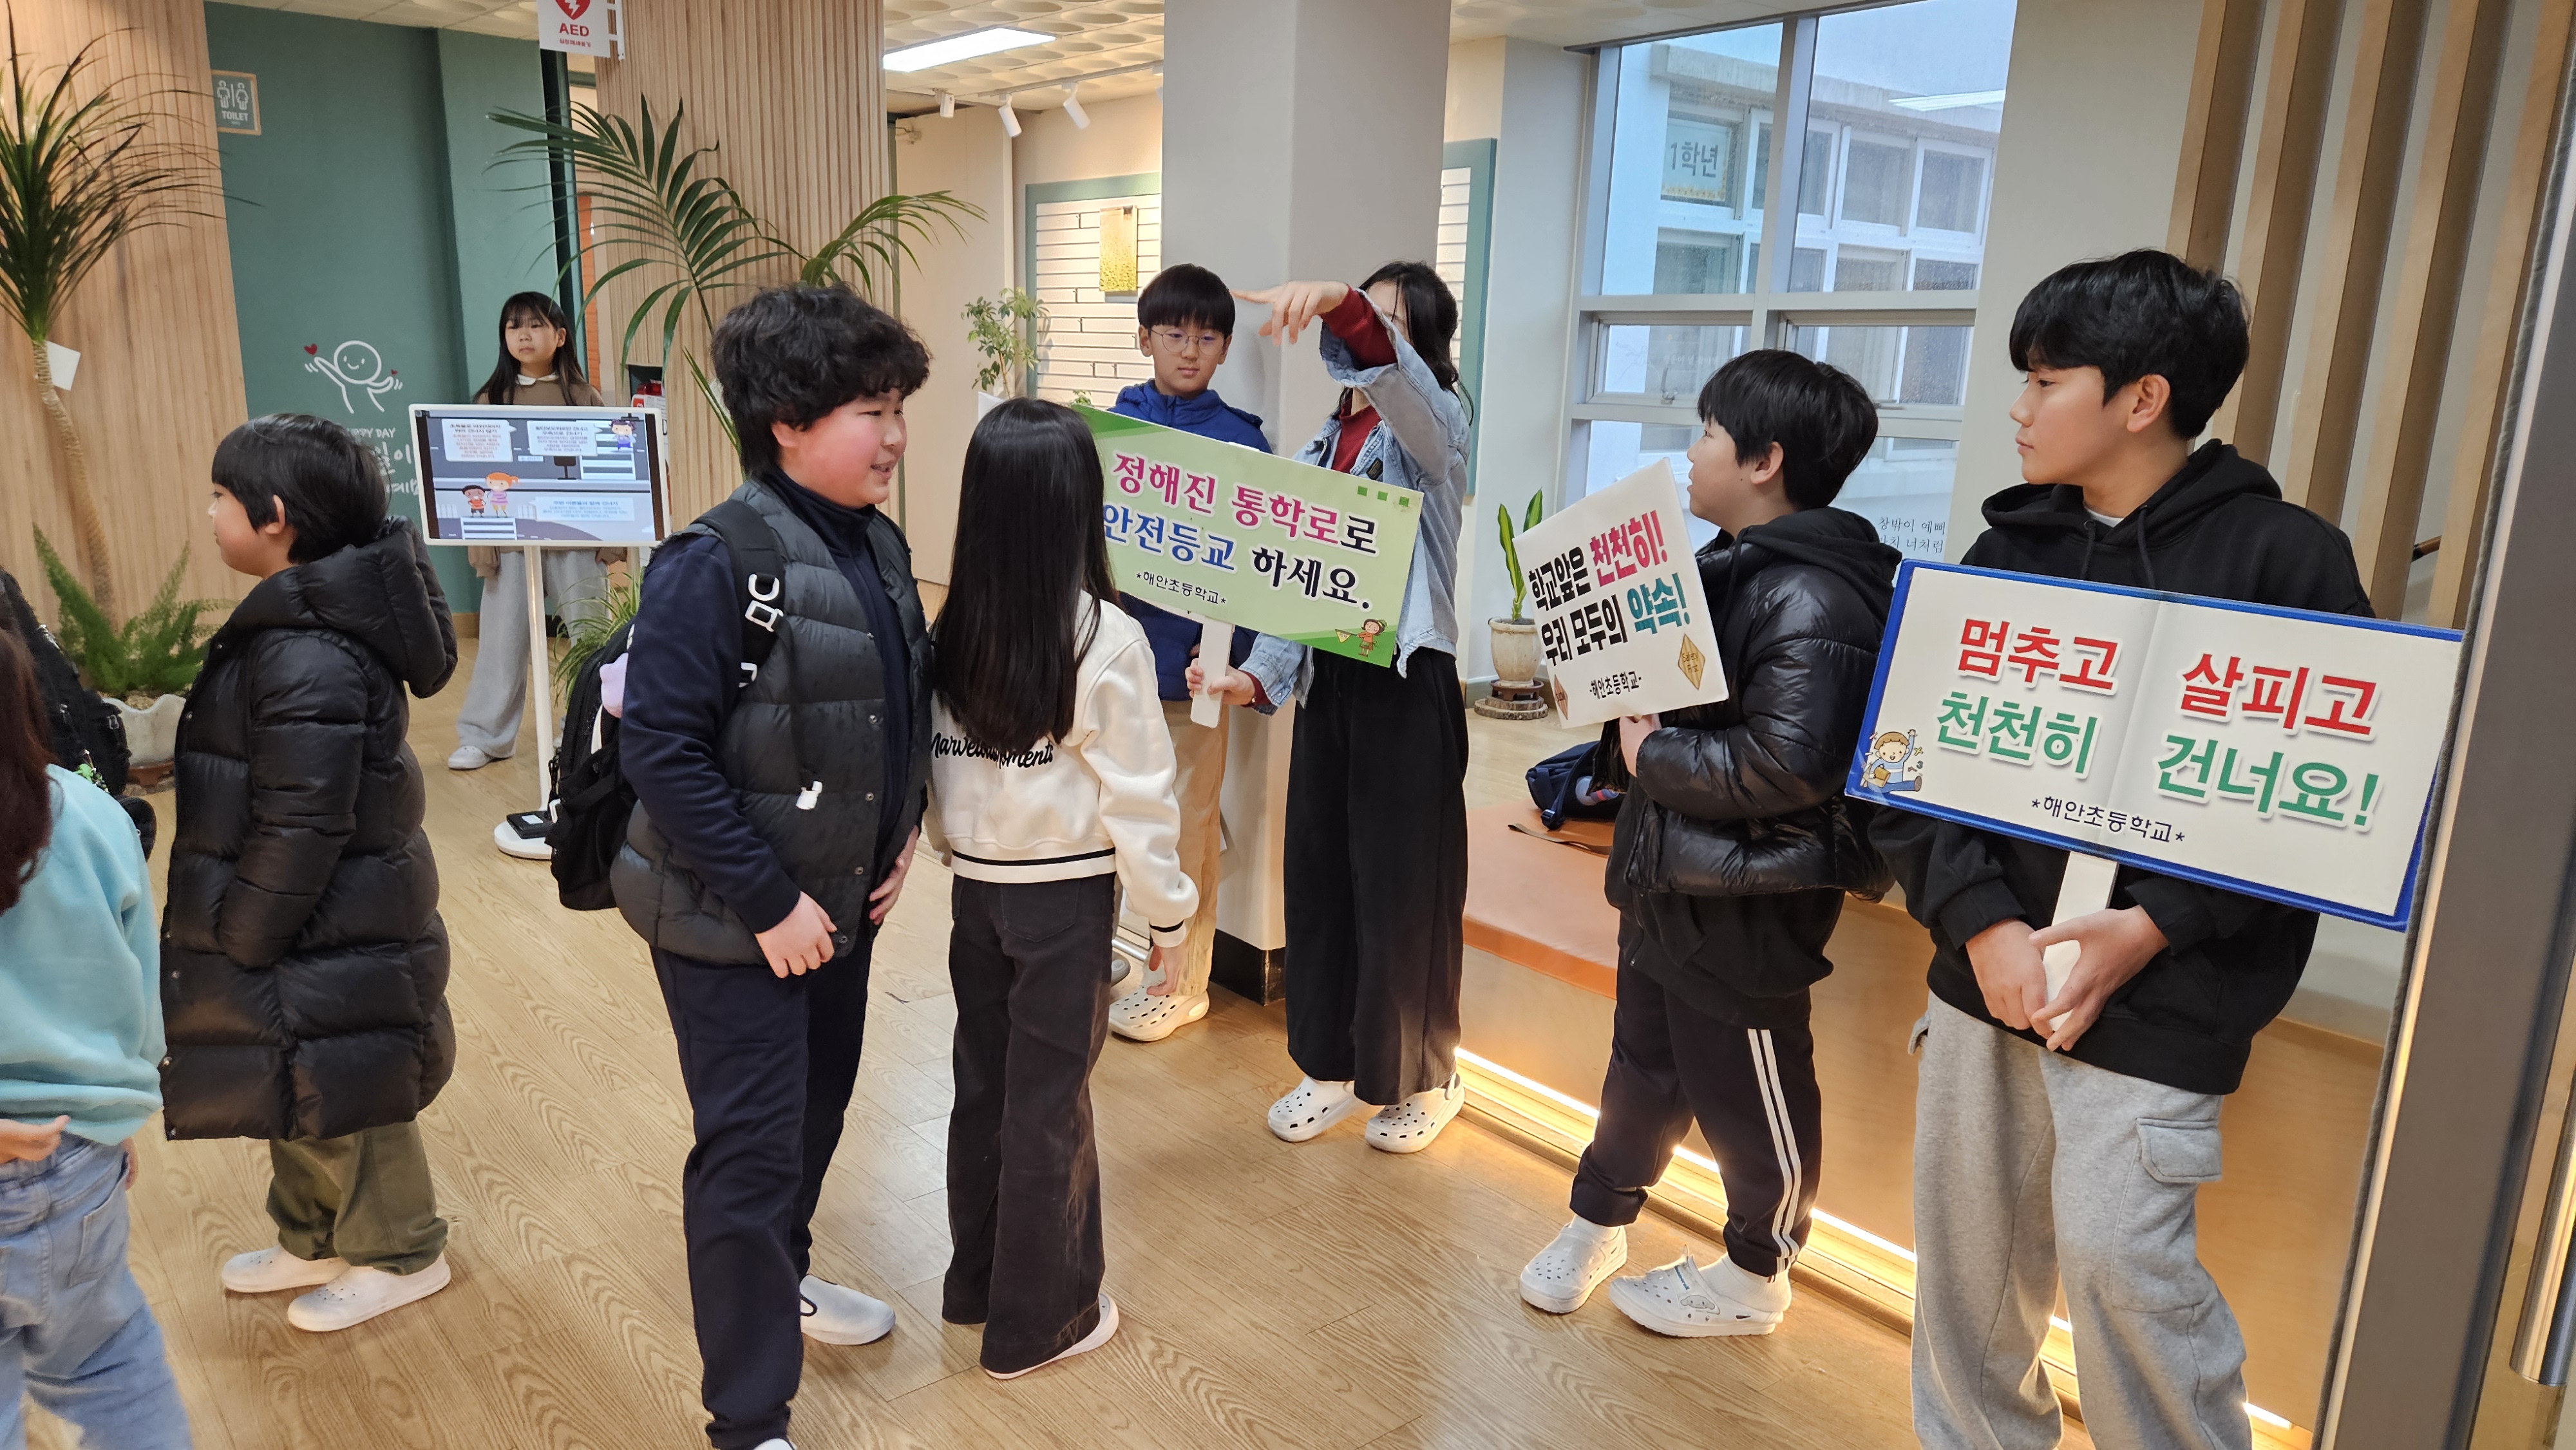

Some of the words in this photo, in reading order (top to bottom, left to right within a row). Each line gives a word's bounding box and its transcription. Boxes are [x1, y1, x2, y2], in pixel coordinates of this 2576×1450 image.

[559, 23, 589, 37] AED
[222, 110, 249, 122] TOILET
[1671, 141, 1718, 178] 1학년
[375, 427, 396, 438] DAY
[1113, 453, 1216, 514] 정해진
[1231, 485, 1377, 554] 통학로로
[1879, 516, 1915, 533] 창밖이
[1921, 520, 1946, 535] 예뻐
[1103, 504, 1235, 570] 안전등교
[1252, 547, 1370, 609] 하세요.
[1528, 546, 1591, 611] 학교앞은
[1589, 509, 1667, 587] 천천히!
[1906, 537, 1944, 553] 너처럼
[1541, 616, 1573, 666] 우리
[1569, 594, 1628, 655] 모두의
[1627, 572, 1690, 635] 약속!
[1958, 618, 2119, 690] 멈추고
[2181, 653, 2377, 735] 살피고
[1937, 691, 2098, 774] 천천히
[2157, 734, 2380, 826] 건너요!
